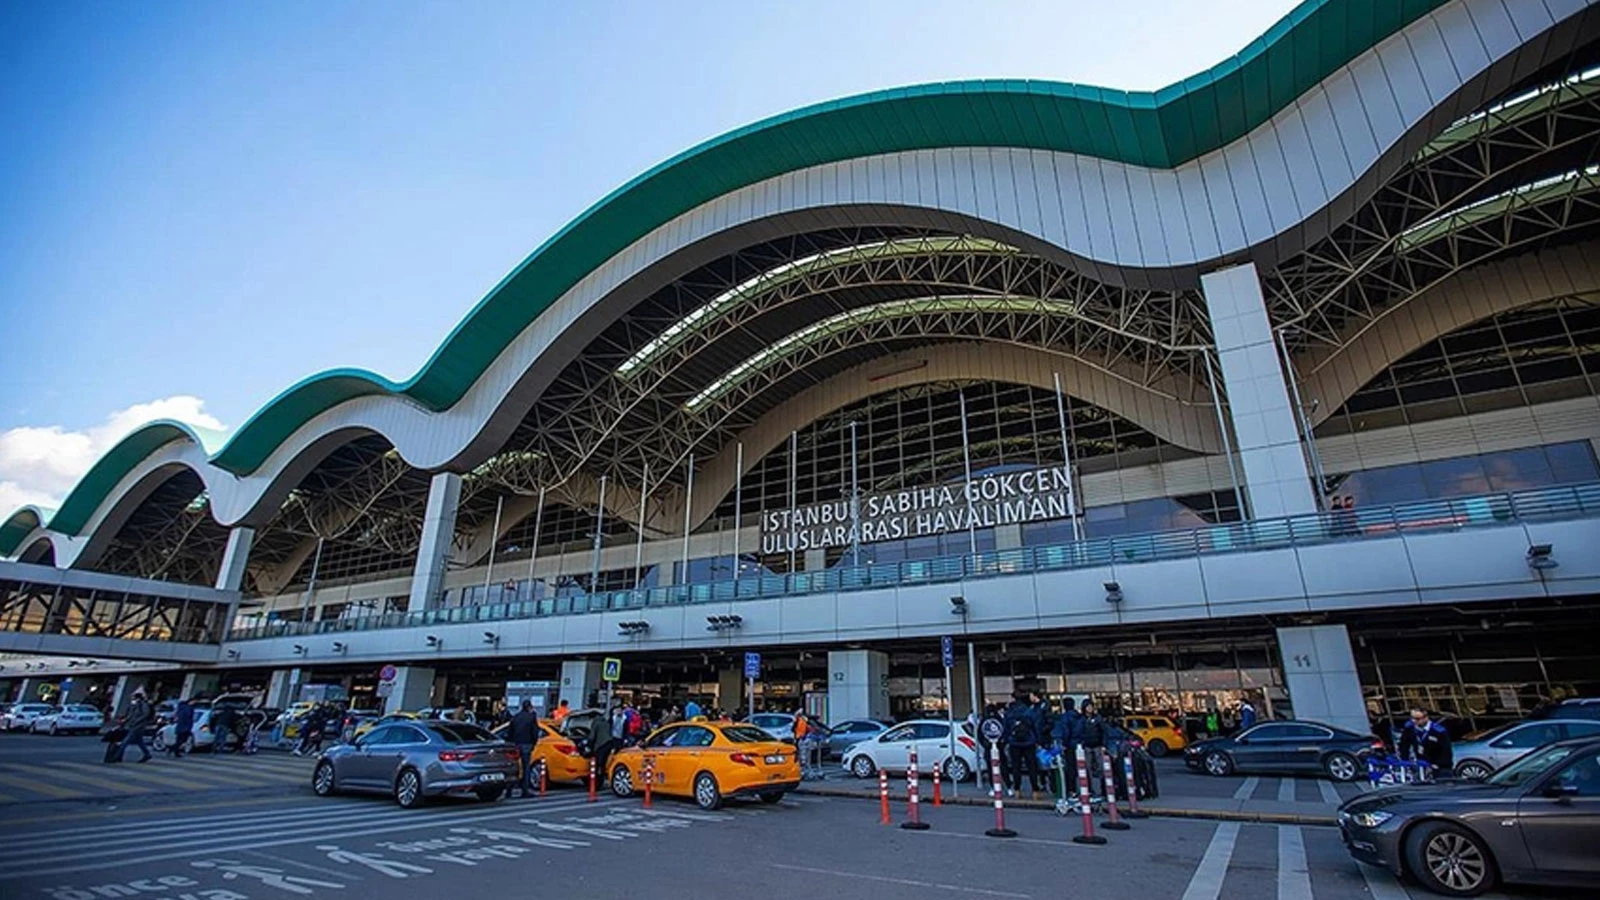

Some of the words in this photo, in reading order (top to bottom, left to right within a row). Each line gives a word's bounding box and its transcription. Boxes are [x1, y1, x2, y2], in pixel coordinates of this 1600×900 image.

[868, 486, 954, 517] SABİHA
[965, 467, 1071, 501] GÖKÇEN
[763, 519, 909, 554] ULUSLARARASI
[1293, 655, 1311, 667] 11
[833, 672, 844, 681] 12
[41, 875, 199, 900] önce
